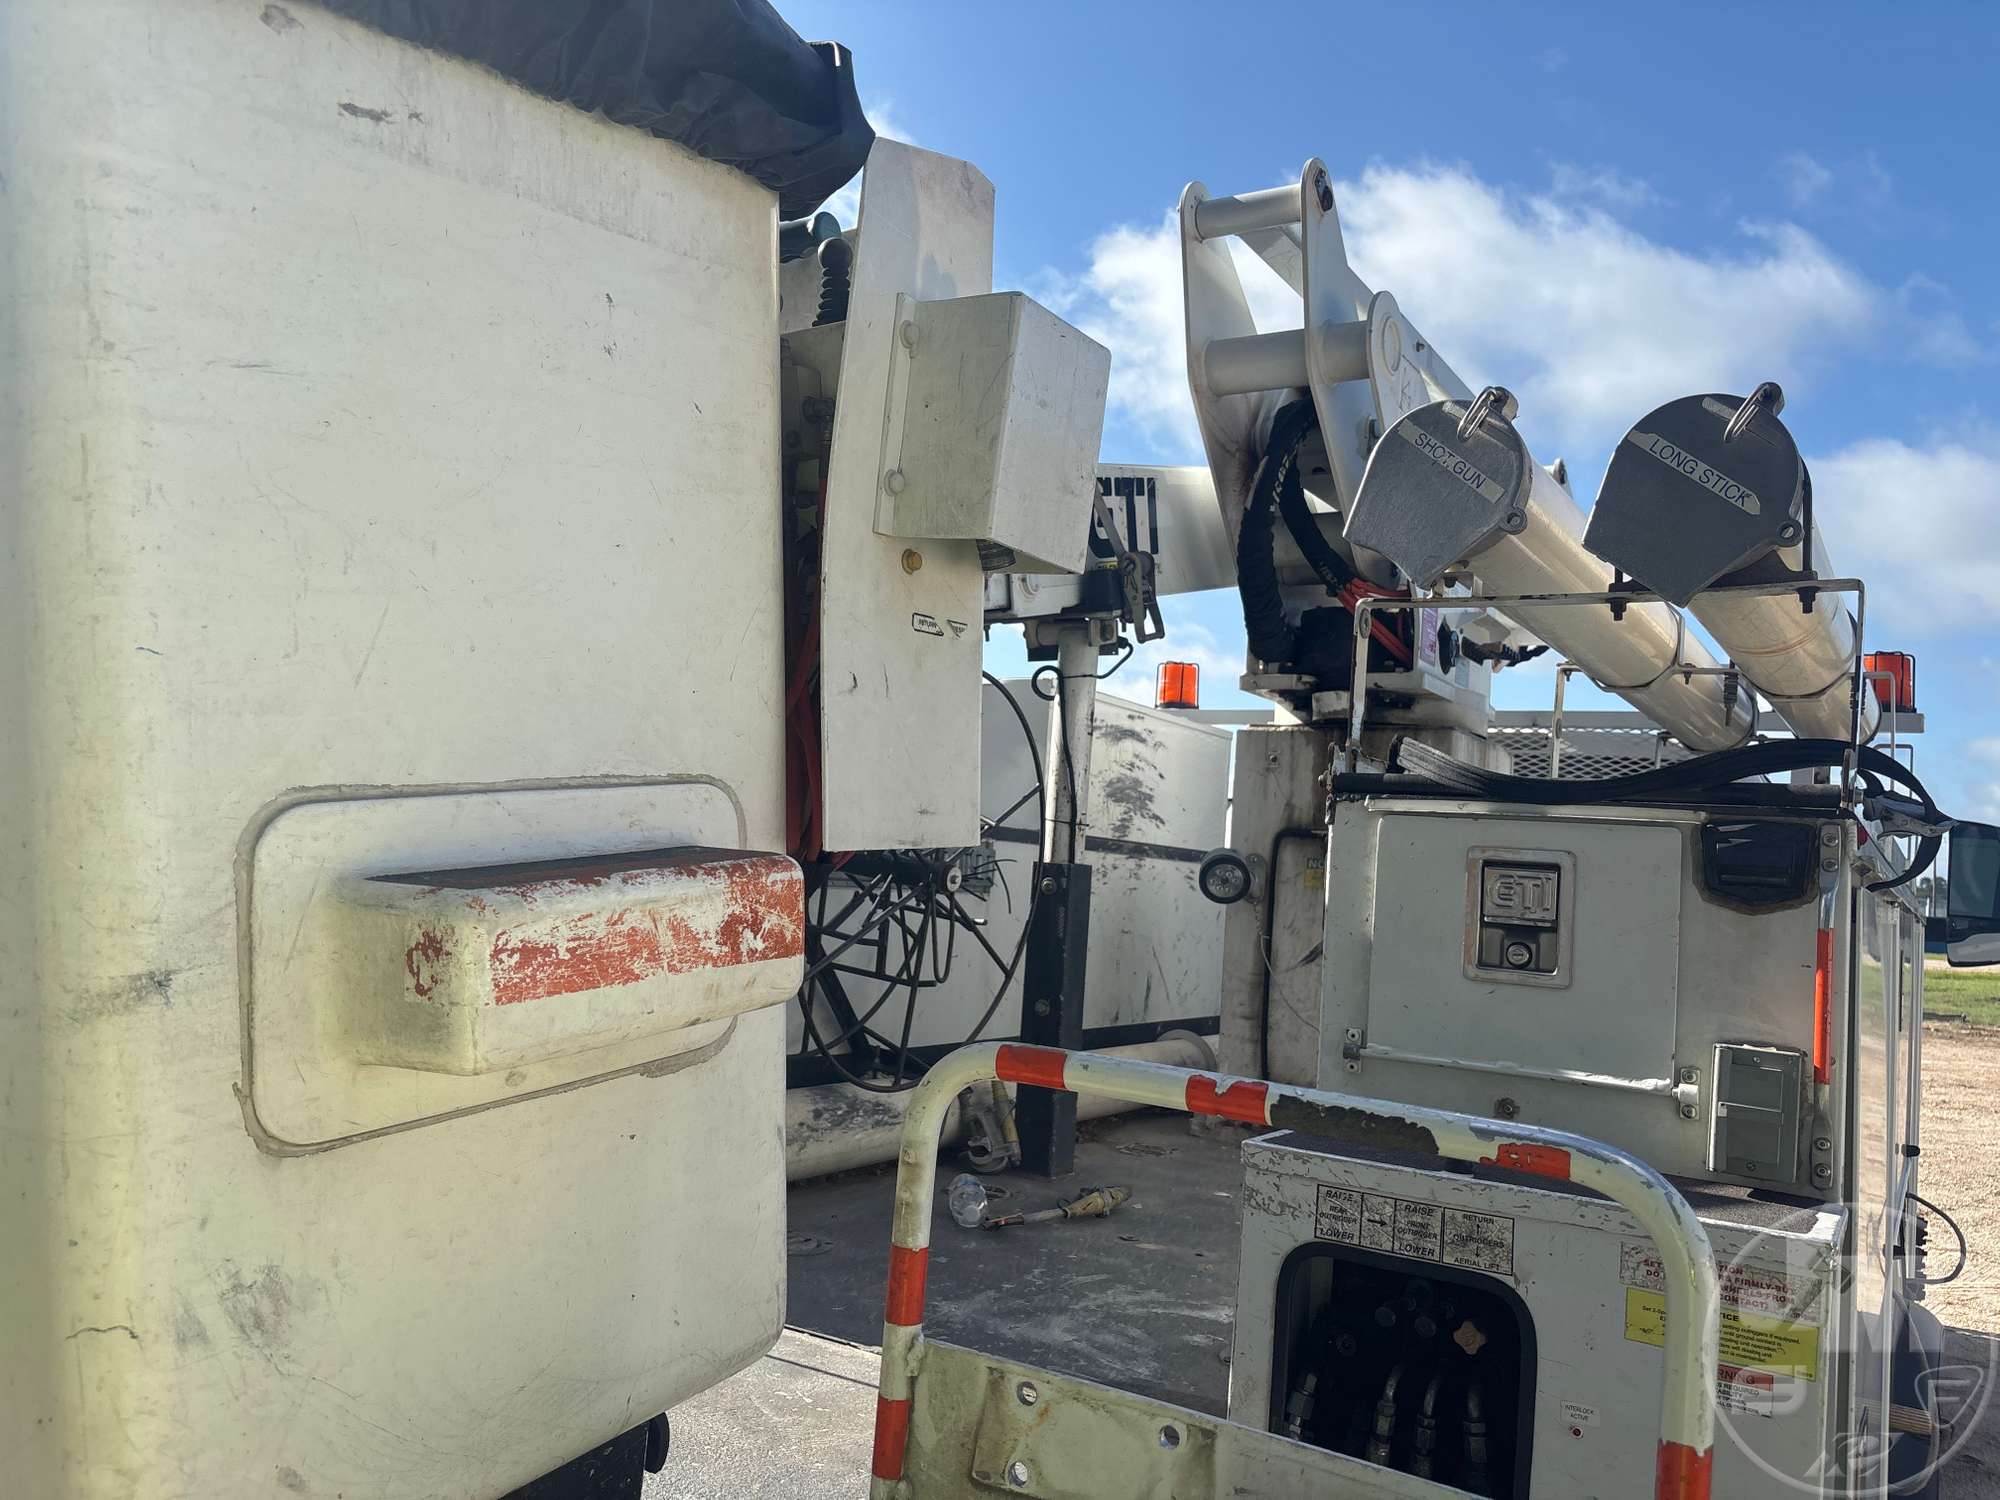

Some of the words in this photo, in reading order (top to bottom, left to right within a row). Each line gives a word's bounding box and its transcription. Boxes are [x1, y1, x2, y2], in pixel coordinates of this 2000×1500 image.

[1415, 432, 1455, 465] SHOT
[1452, 461, 1486, 489] GUN
[1650, 438, 1698, 475] LONG
[1699, 468, 1752, 508] STICK
[1404, 1204, 1434, 1217] RAISE
[1407, 1220, 1431, 1230] FRONT
[1462, 1213, 1495, 1225] RETURN
[1320, 1228, 1355, 1241] LOWER
[1397, 1227, 1438, 1240] OUTRIGGER
[1453, 1233, 1505, 1248] OUTRIGGERS
[1398, 1243, 1435, 1257] LOWER
[1454, 1257, 1482, 1268] AERIAL
[1484, 1262, 1501, 1271] LIFT
[1646, 1269, 1660, 1278] DO
[1719, 1369, 1755, 1385] RNING
